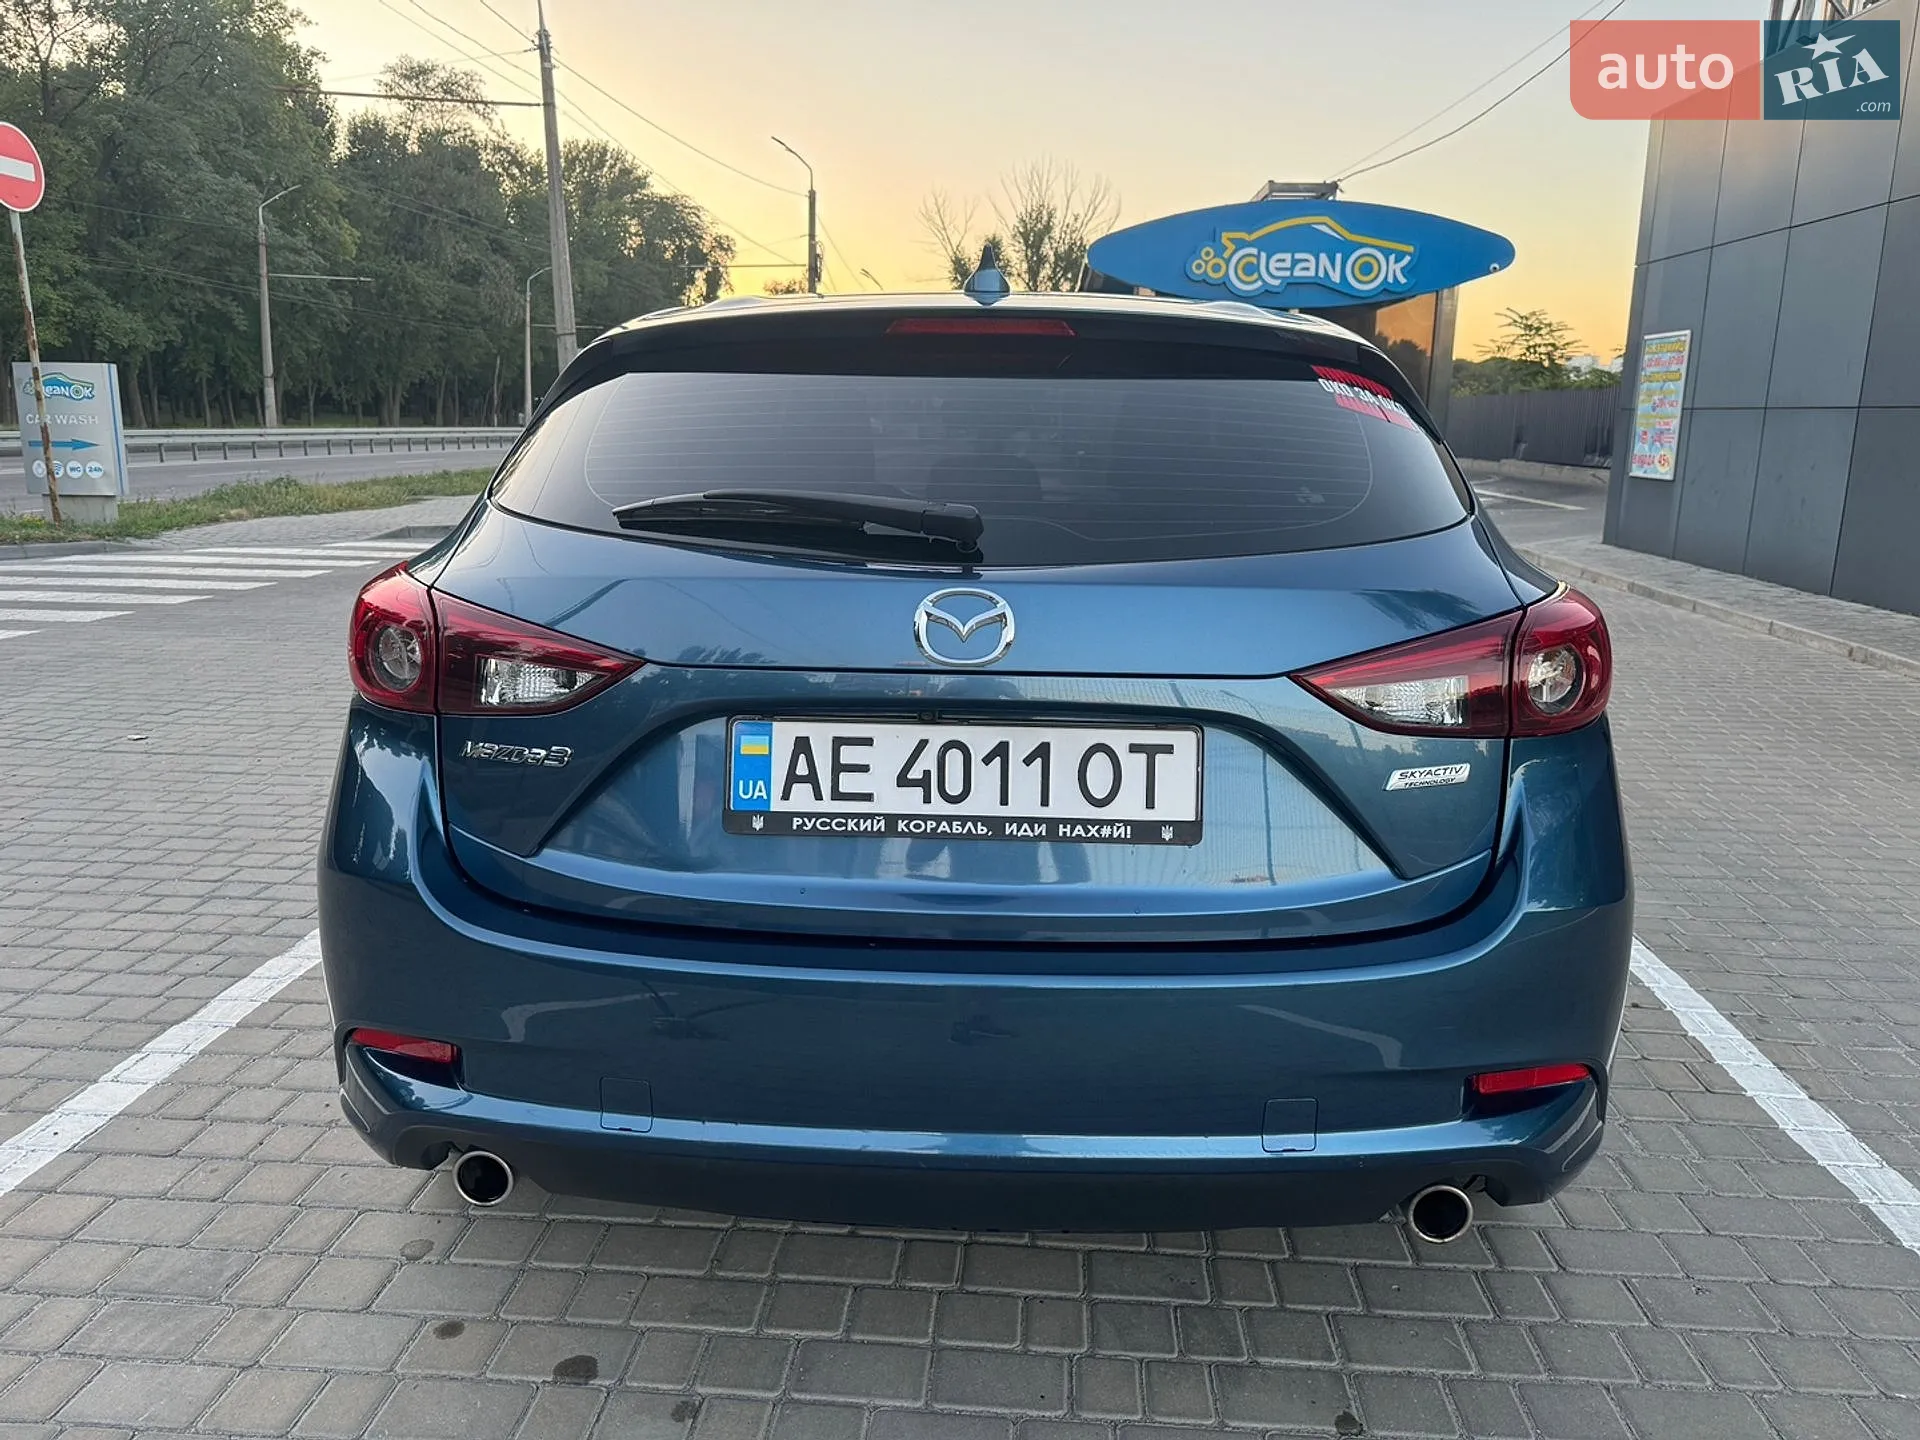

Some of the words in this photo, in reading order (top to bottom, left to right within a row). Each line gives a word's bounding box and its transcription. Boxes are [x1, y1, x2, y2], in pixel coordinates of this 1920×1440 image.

[54, 414, 98, 424] WASH
[779, 736, 875, 802] AE
[895, 738, 1051, 808] 4011
[1077, 743, 1174, 809] OT
[1397, 765, 1463, 780] SKYACTIV
[738, 779, 768, 800] UA
[1404, 777, 1456, 788] TECHNOLOGY
[791, 816, 886, 833] РУССКИЙ
[897, 820, 993, 836] КОРАБЛЬ,
[1004, 823, 1047, 838] ИДИ
[1058, 824, 1132, 840] НАХ#Й!
